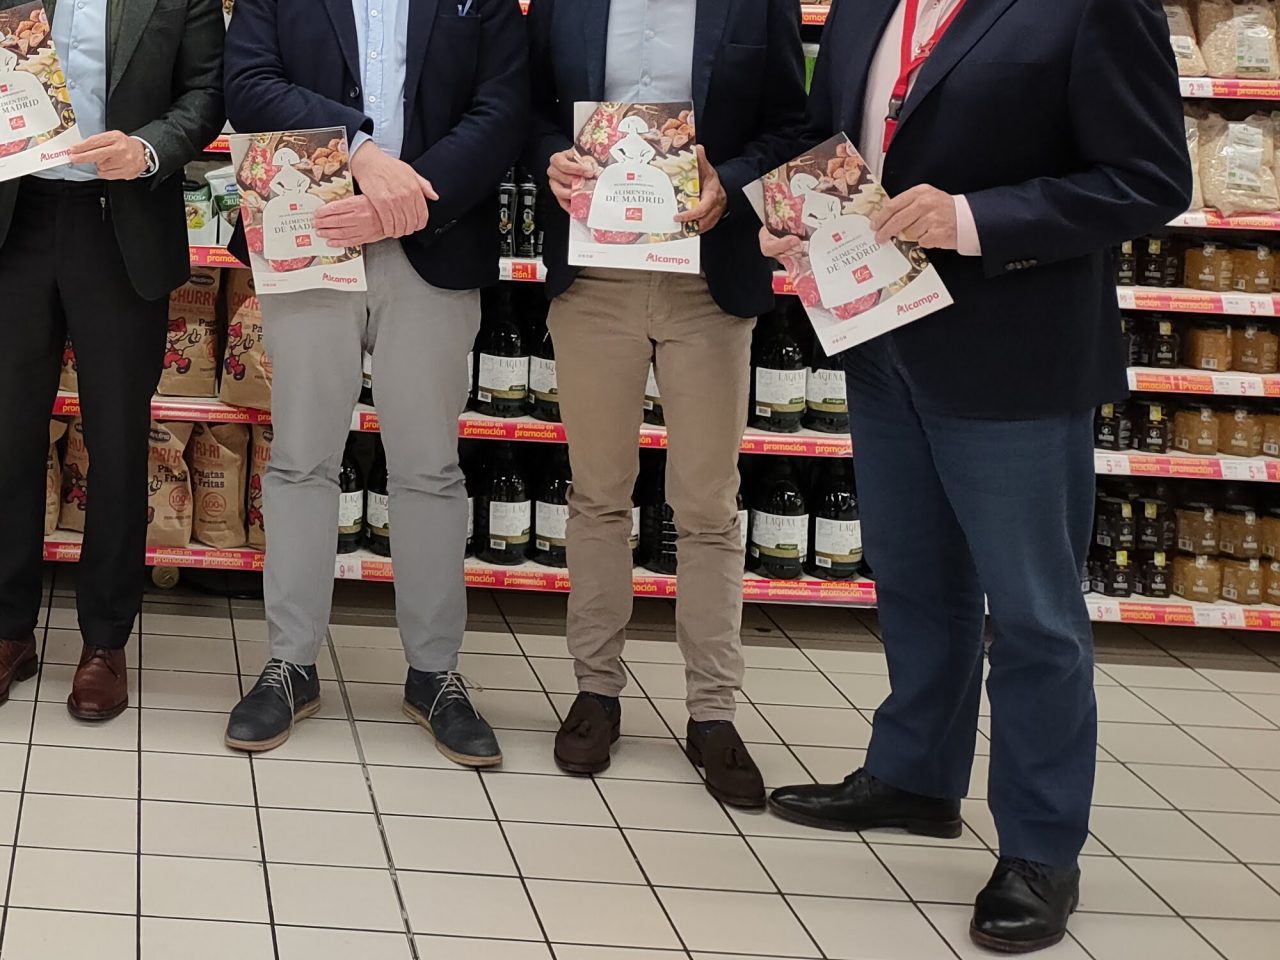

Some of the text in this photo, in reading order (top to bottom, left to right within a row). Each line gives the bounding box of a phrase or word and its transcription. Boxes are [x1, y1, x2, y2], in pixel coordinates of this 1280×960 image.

[2, 98, 39, 113] MADRID
[40, 149, 72, 161] Alcamp
[622, 196, 665, 204] MADRID
[646, 252, 690, 265] Alcampo
[841, 243, 881, 268] MADRID
[322, 272, 358, 285] Alcampo
[896, 292, 940, 316] Alcampo
[464, 427, 506, 436] promoción
[515, 430, 557, 438] promoción
[763, 443, 807, 451] promoción
